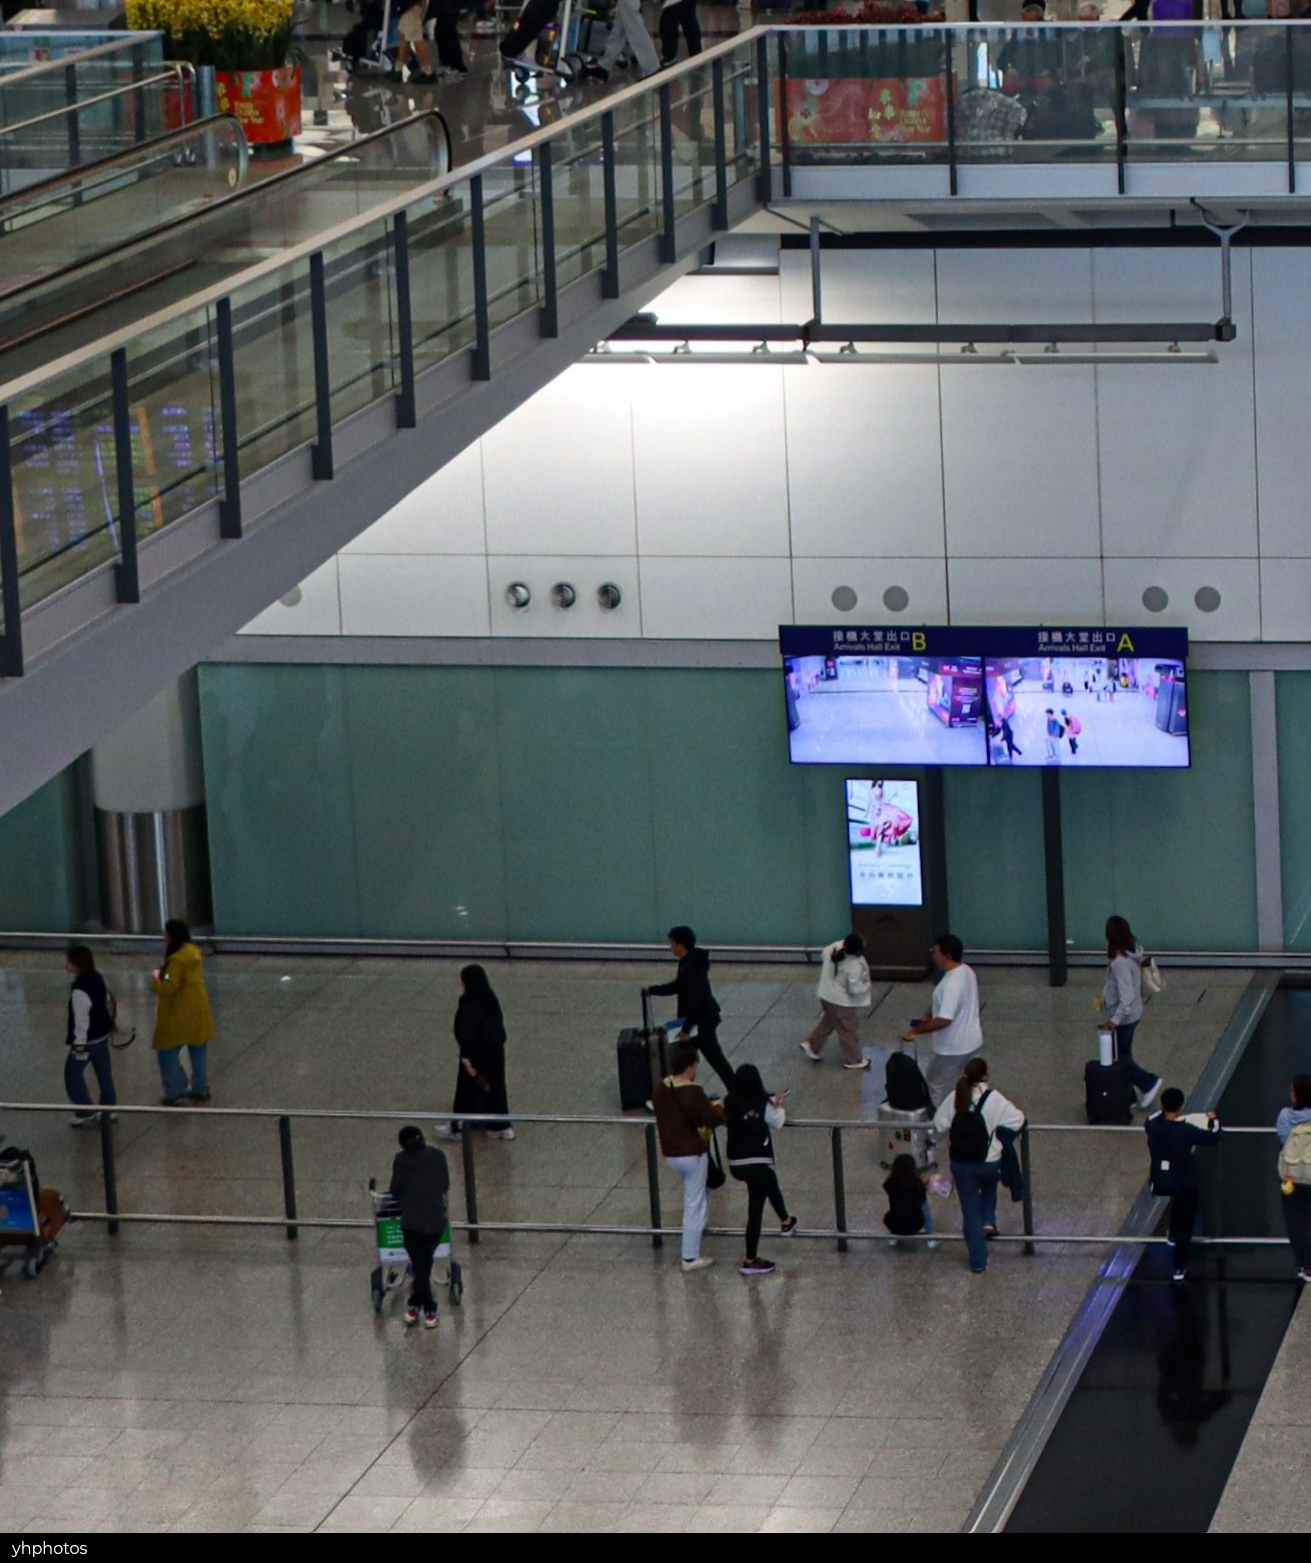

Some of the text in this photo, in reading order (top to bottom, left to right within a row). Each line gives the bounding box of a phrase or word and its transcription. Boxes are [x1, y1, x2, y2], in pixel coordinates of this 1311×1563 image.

[833, 630, 910, 642] 接機大堂出口
[912, 632, 927, 651] B
[1038, 631, 1116, 643] 接機大堂出口
[833, 642, 901, 651] Arrivals Hall Exit
[1038, 643, 1106, 652] Arrivals Hall Exit
[1117, 633, 1135, 652] A
